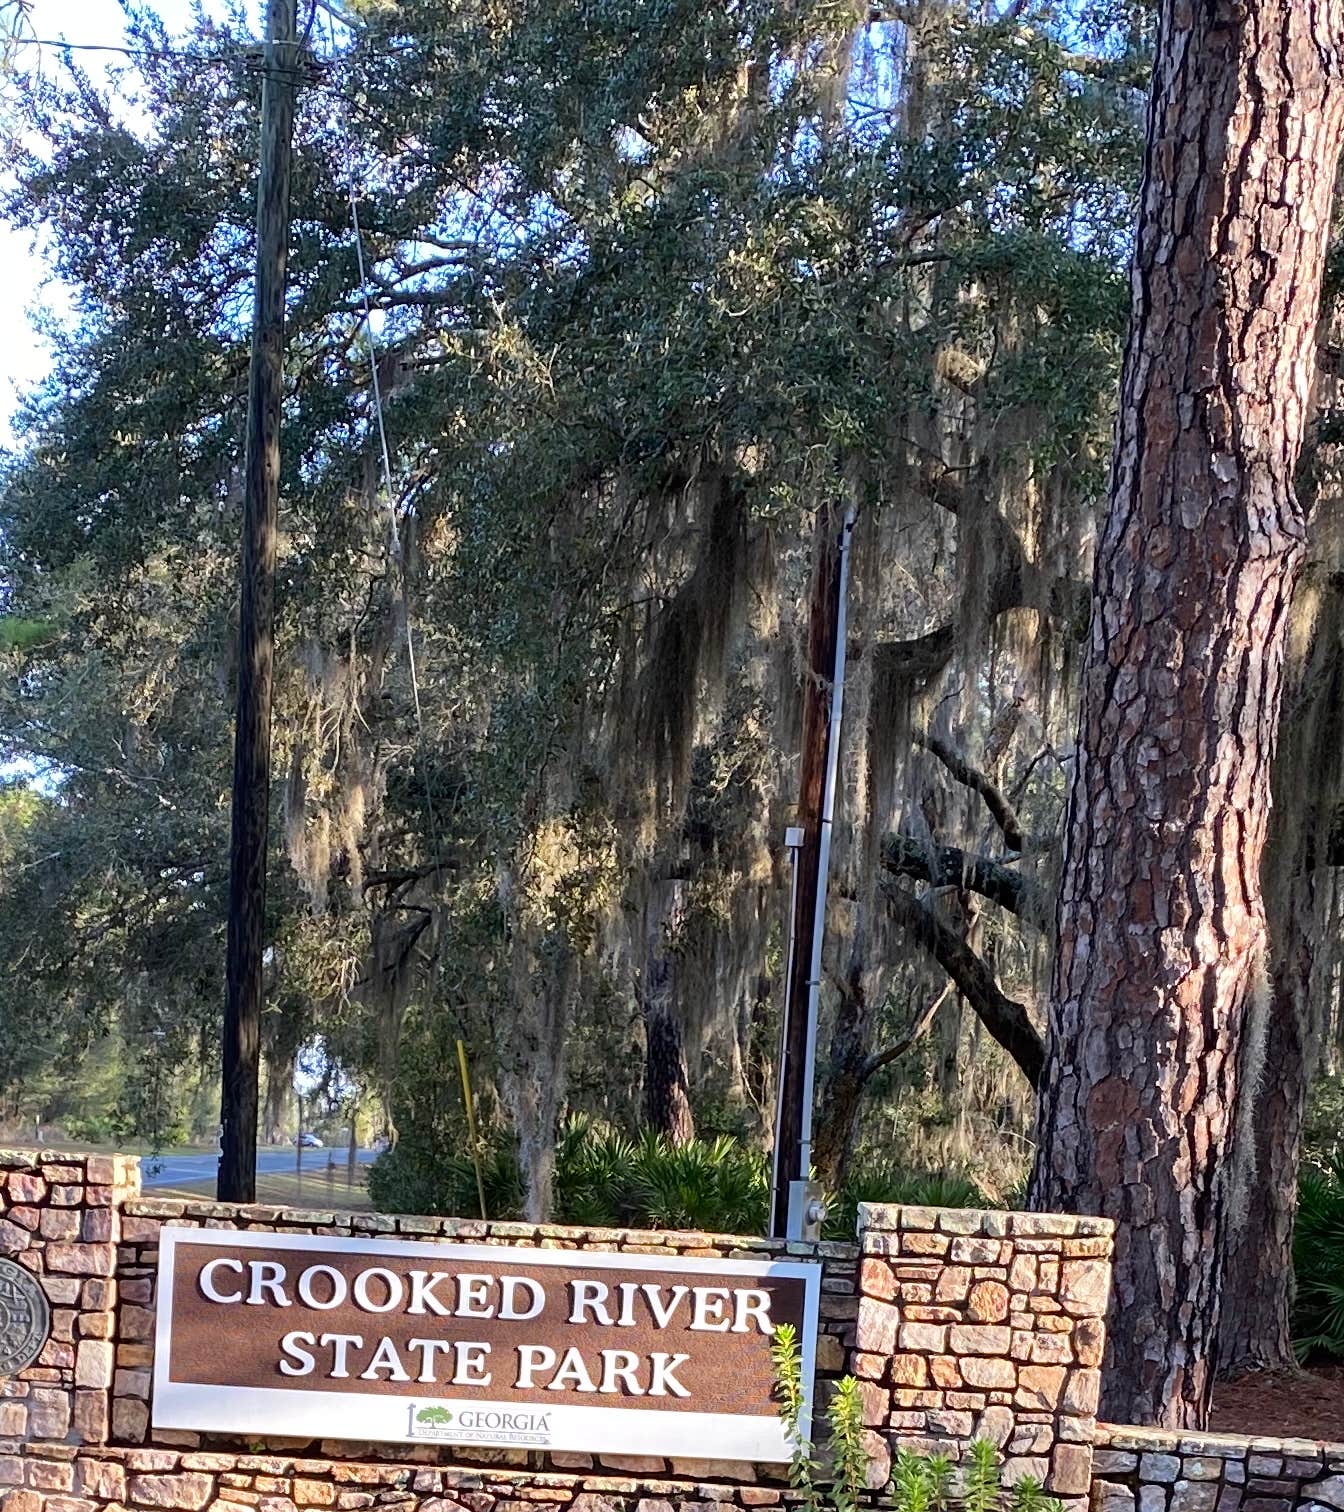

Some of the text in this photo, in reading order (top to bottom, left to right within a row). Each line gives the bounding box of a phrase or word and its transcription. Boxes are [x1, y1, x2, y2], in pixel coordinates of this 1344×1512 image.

[199, 1257, 778, 1336] CROOKED RIVER
[279, 1331, 692, 1398] STATE PARK
[458, 1411, 550, 1432] GEORGIA
